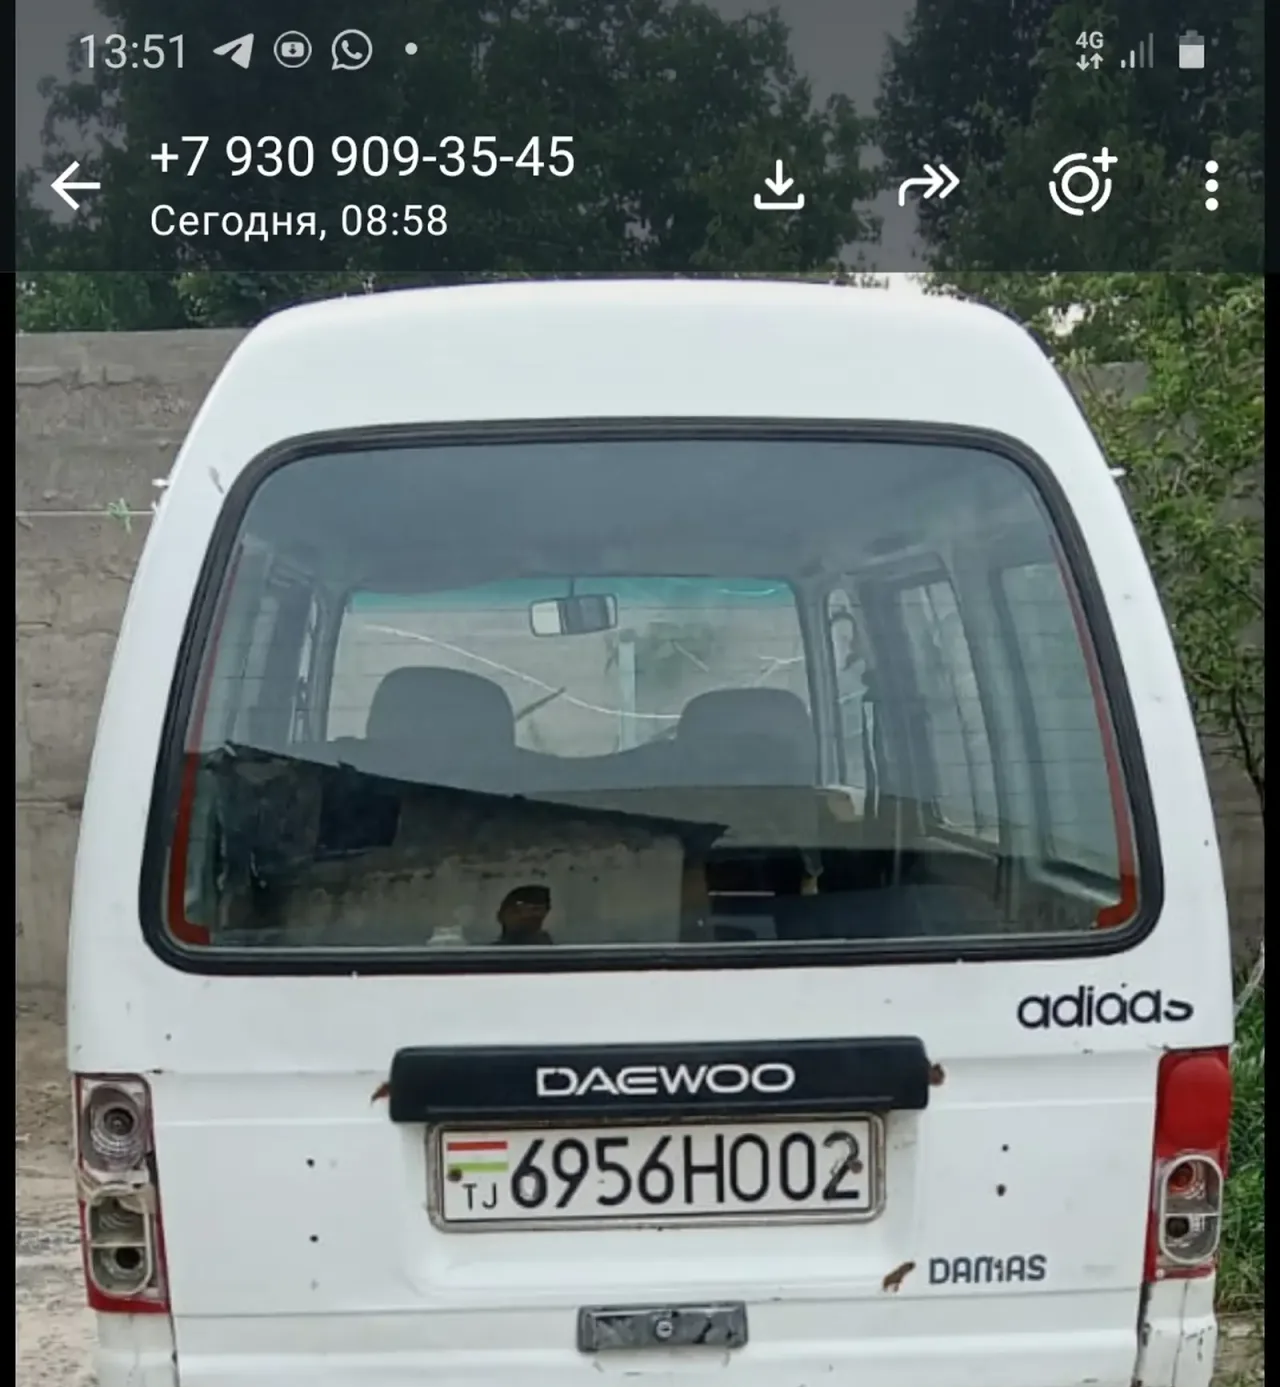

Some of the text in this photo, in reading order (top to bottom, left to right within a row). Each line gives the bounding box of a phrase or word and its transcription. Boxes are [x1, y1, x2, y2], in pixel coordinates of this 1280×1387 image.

[536, 1063, 795, 1097] DAEWOO
[462, 1182, 498, 1210] TJ
[929, 1254, 1047, 1284] DAMAS
